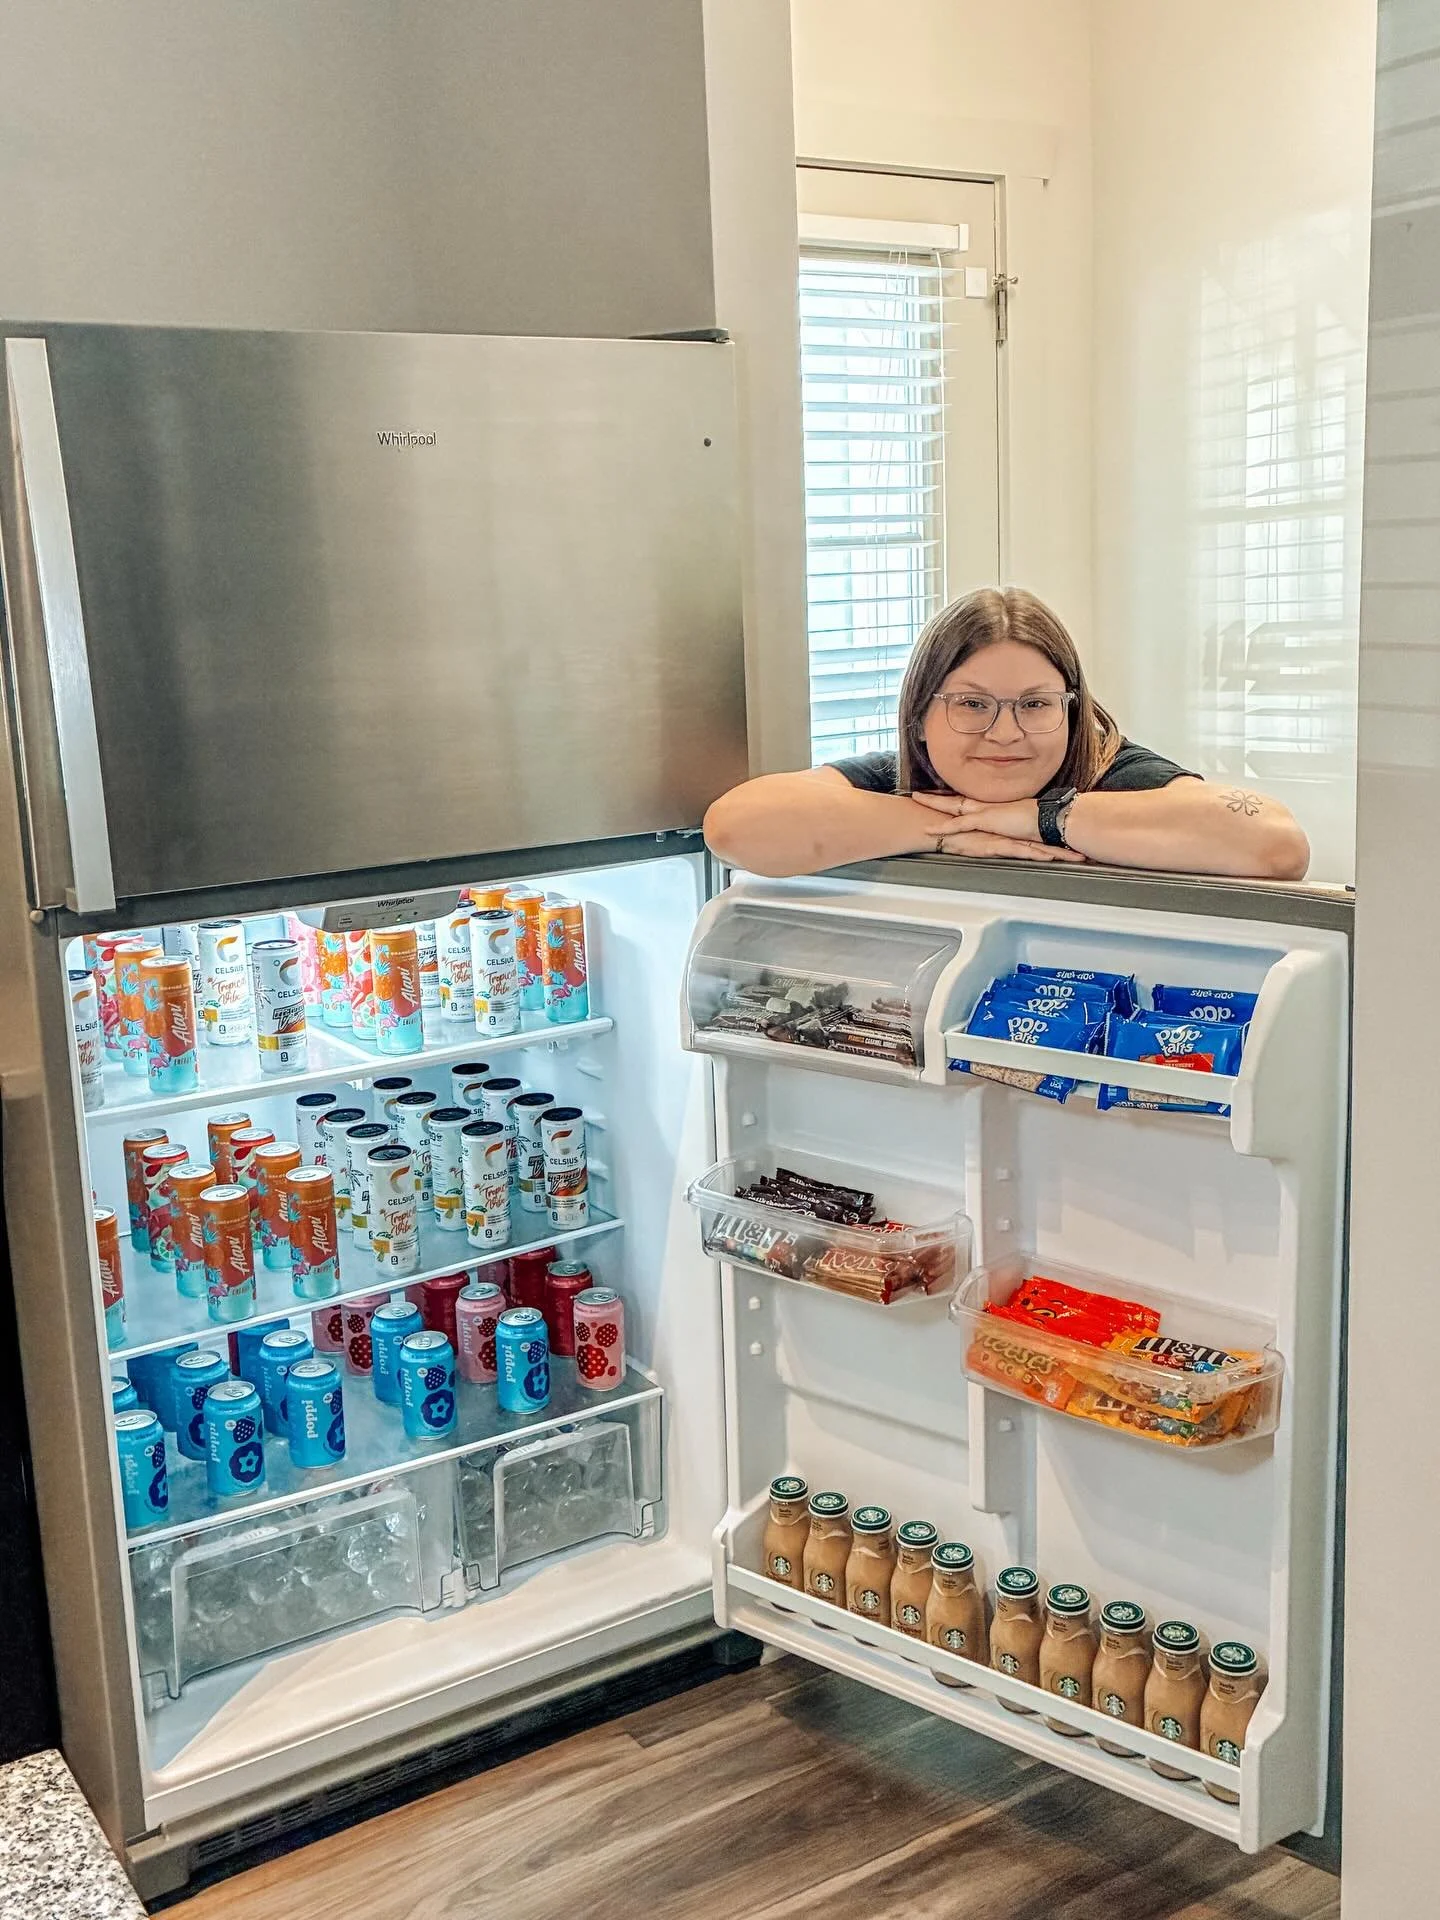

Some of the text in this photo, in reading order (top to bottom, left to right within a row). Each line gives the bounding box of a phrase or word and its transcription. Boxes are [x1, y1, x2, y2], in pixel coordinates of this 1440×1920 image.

[377, 432, 436, 448] Whirlpool
[486, 956, 514, 966] CELSIUS
[570, 938, 587, 977] Alani
[397, 966, 419, 1008] Alani
[167, 1001, 193, 1046] Alani
[1162, 1041, 1194, 1057] tarts
[482, 1169, 507, 1181] CELSIUS
[550, 1157, 579, 1166] CELSIUS
[387, 1193, 415, 1207] CELSIUS
[308, 1215, 333, 1255] Alani
[225, 1235, 250, 1277] Alani
[501, 1344, 517, 1384] poppi
[400, 1366, 414, 1408] poppi
[301, 1399, 319, 1440] poppi
